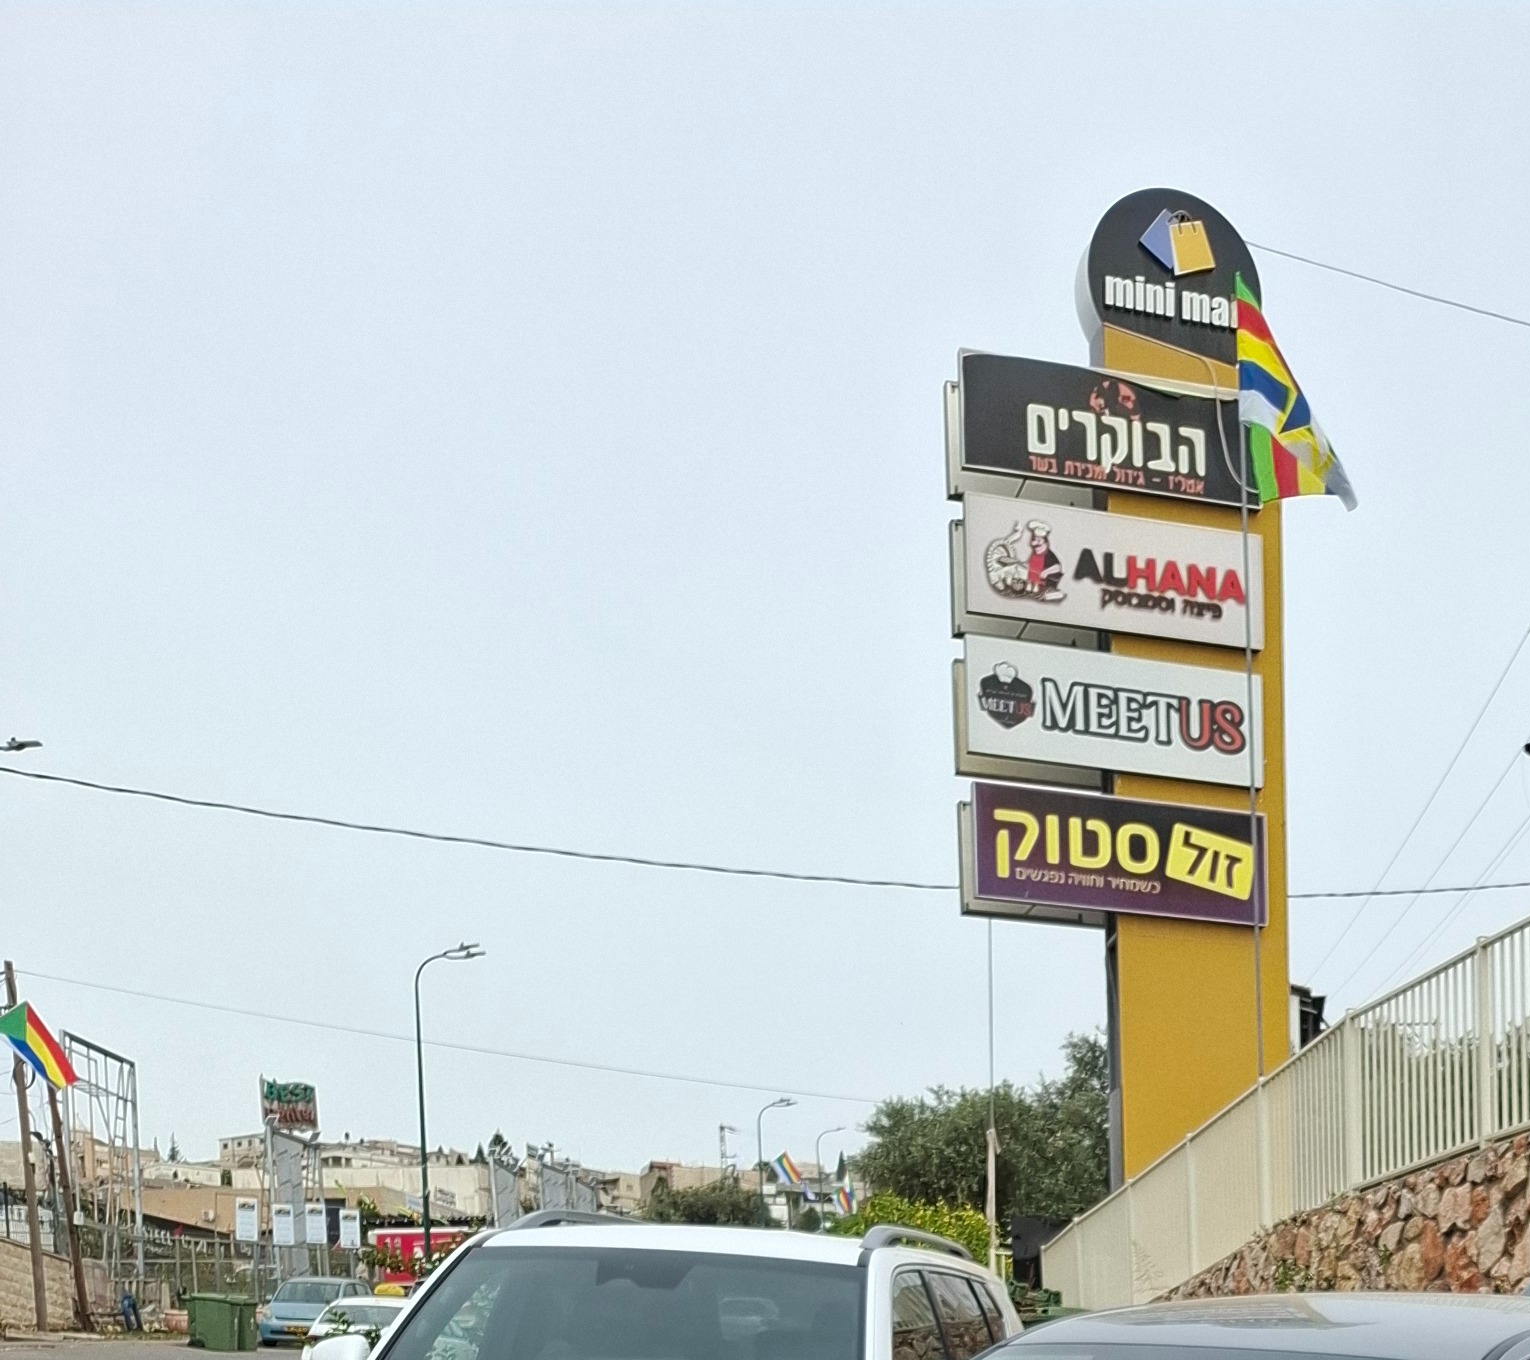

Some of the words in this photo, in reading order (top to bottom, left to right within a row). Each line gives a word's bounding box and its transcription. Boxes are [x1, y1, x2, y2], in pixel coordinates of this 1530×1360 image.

[1105, 275, 1175, 318] mini
[1027, 403, 1206, 477] הבוקרים
[1028, 455, 1058, 474] בשר
[1113, 465, 1145, 486] גידול
[1073, 547, 1246, 605] ALHANA
[993, 808, 1160, 878] סטוק
[1182, 830, 1242, 889] זול
